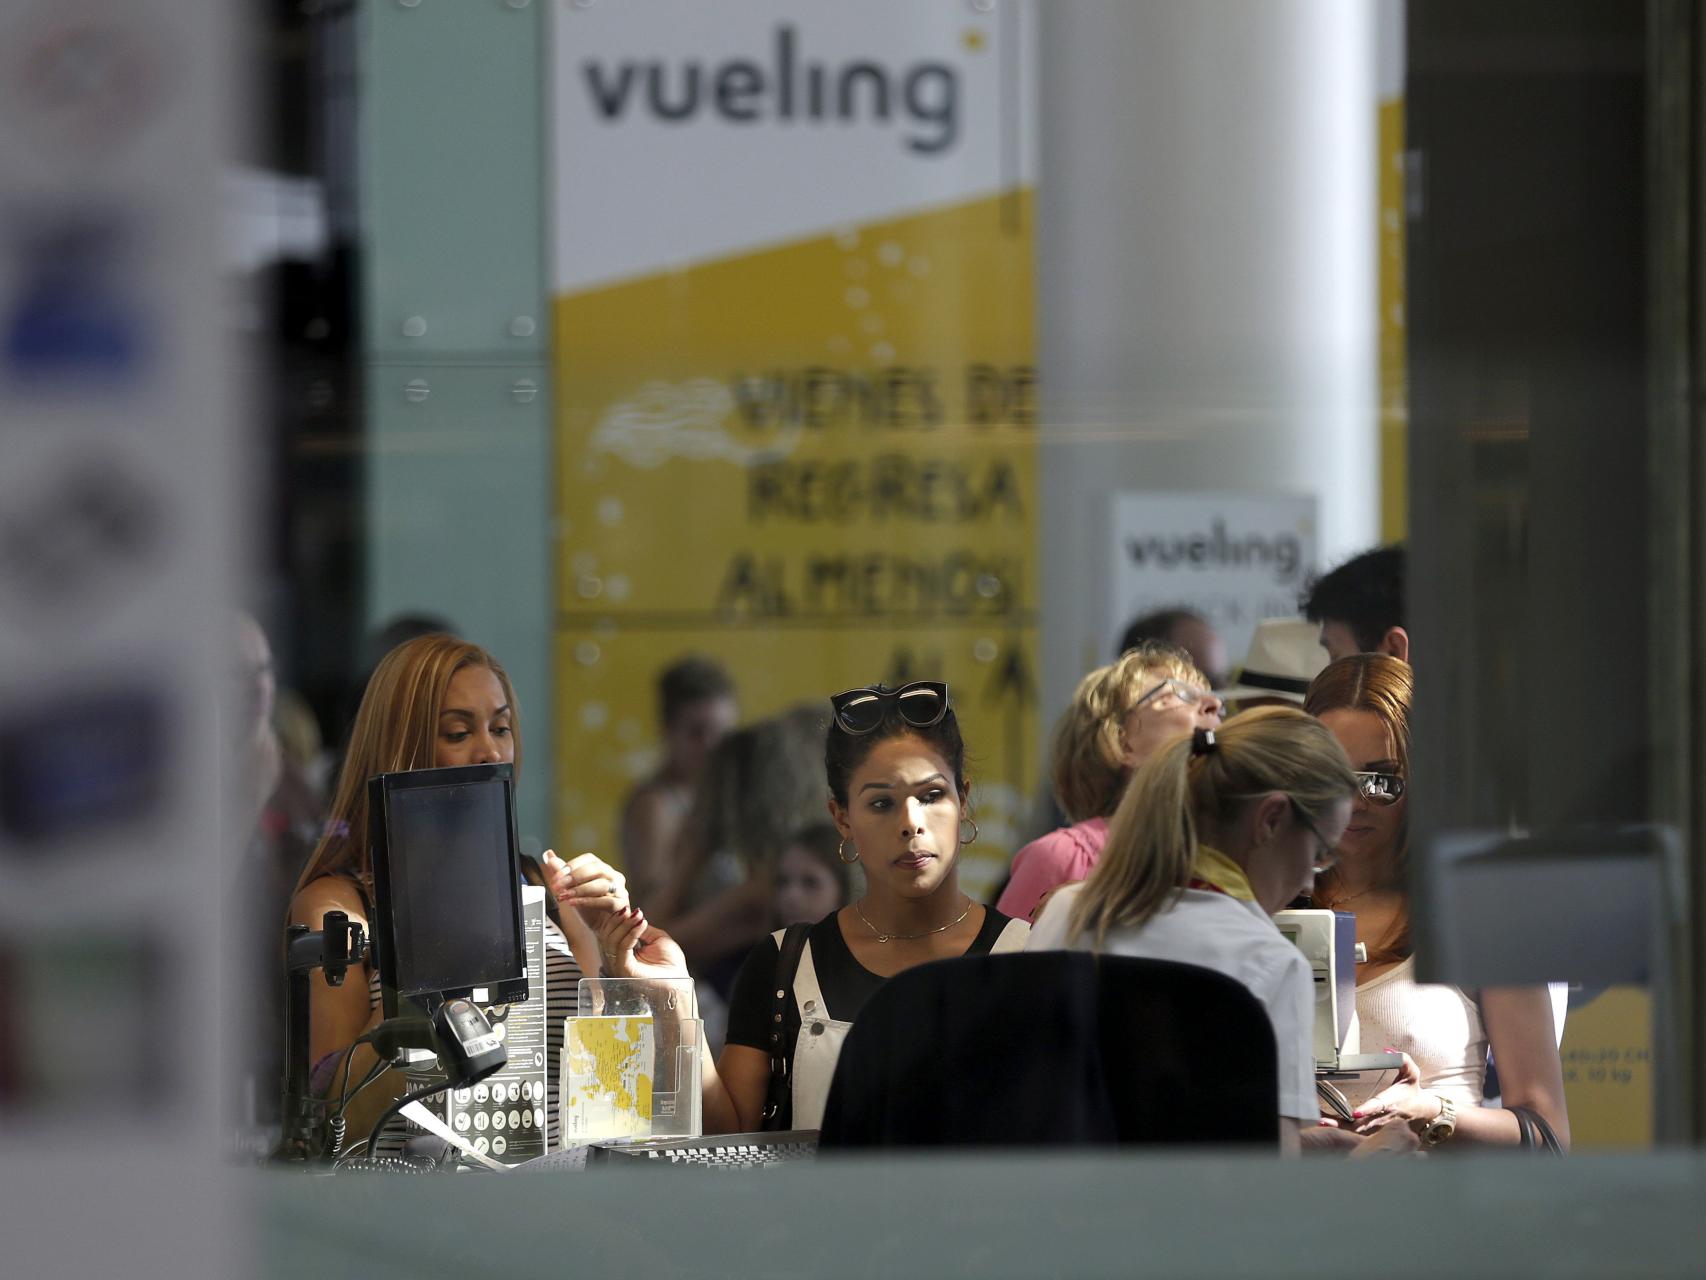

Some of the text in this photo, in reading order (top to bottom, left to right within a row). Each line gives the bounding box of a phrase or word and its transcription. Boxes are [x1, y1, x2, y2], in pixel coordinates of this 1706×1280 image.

[582, 24, 959, 155] vueling
[747, 455, 1028, 524] REGRESA
[1125, 517, 1302, 584] vueling
